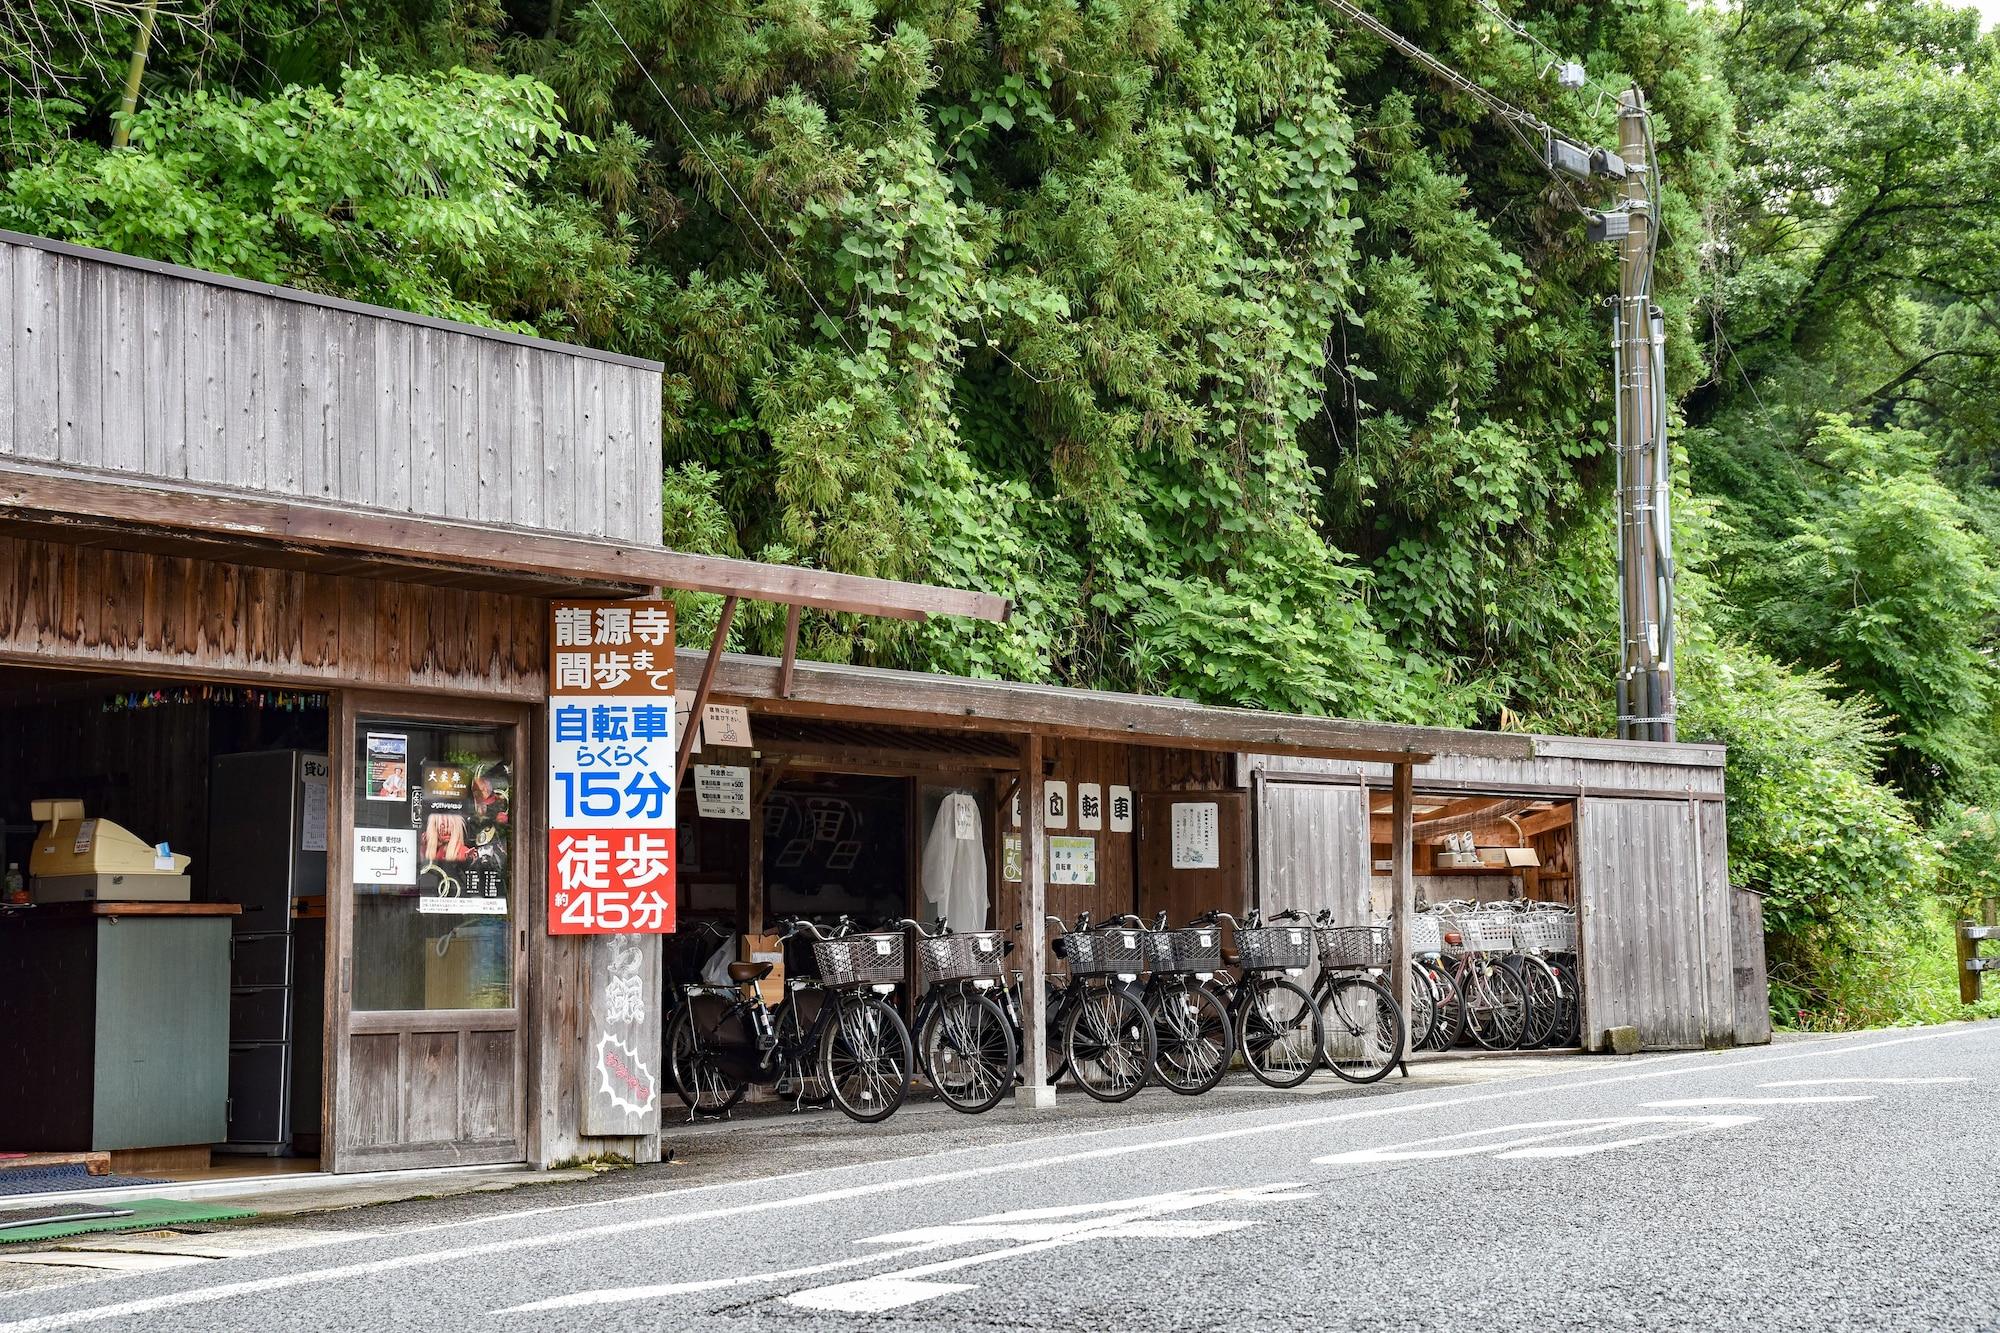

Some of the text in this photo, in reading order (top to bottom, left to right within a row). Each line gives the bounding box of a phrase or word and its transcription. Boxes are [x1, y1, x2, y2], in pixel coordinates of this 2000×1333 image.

[555, 607, 670, 646] 龍源寺
[556, 649, 673, 691] 間歩まで
[555, 704, 668, 743] 自転車
[304, 761, 328, 777] 貸し
[576, 746, 649, 768] らくらく
[555, 771, 671, 819] 15分
[557, 833, 669, 890] 徒歩
[555, 891, 669, 930] 約45分
